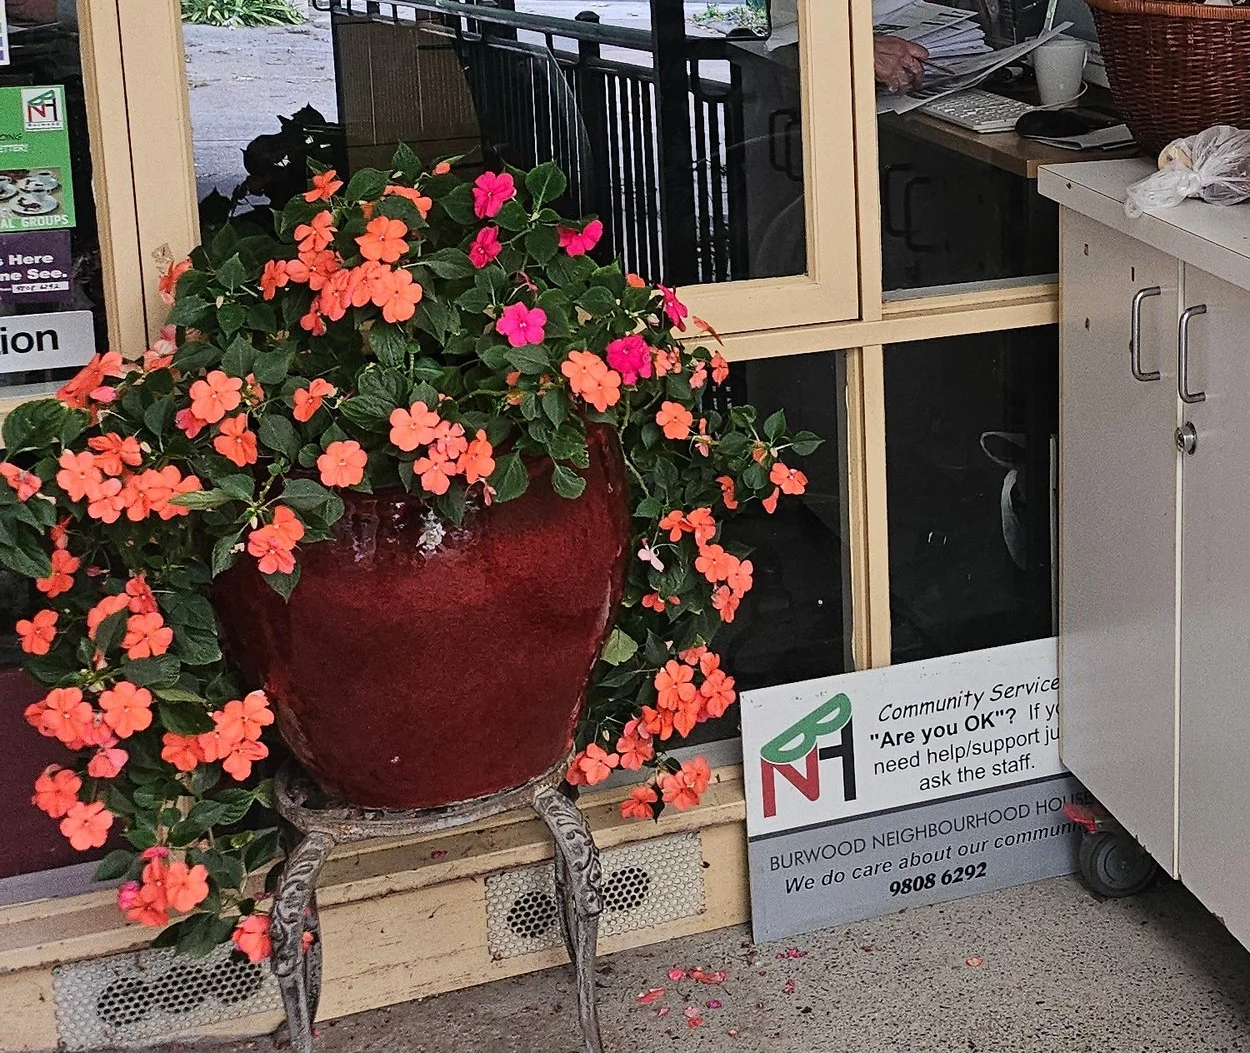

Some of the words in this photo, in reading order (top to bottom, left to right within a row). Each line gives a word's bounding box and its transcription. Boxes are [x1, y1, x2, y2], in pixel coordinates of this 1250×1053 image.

[22, 214, 68, 227] GROUPS
[8, 254, 54, 266] Here
[27, 269, 68, 280] See.
[0, 327, 59, 354] ion
[878, 690, 985, 723] Community
[989, 676, 1060, 702] Service
[870, 730, 915, 748] "Are
[921, 725, 958, 745] you
[964, 708, 1017, 732] OK"?
[1029, 703, 1042, 720] If
[874, 752, 920, 775] need
[927, 727, 1040, 765] help/support
[919, 772, 951, 792] ask
[958, 766, 986, 784] the
[992, 754, 1035, 778] staff.
[770, 837, 866, 871] BURWOOD
[872, 803, 1030, 851] NEIGHBOURHOOD
[786, 875, 815, 894] We
[822, 868, 845, 887] do
[852, 860, 892, 880] care
[898, 845, 952, 870] about
[958, 841, 989, 856] our
[994, 820, 1081, 849] commun
[889, 872, 936, 897] 9808
[941, 862, 988, 885] 6292
